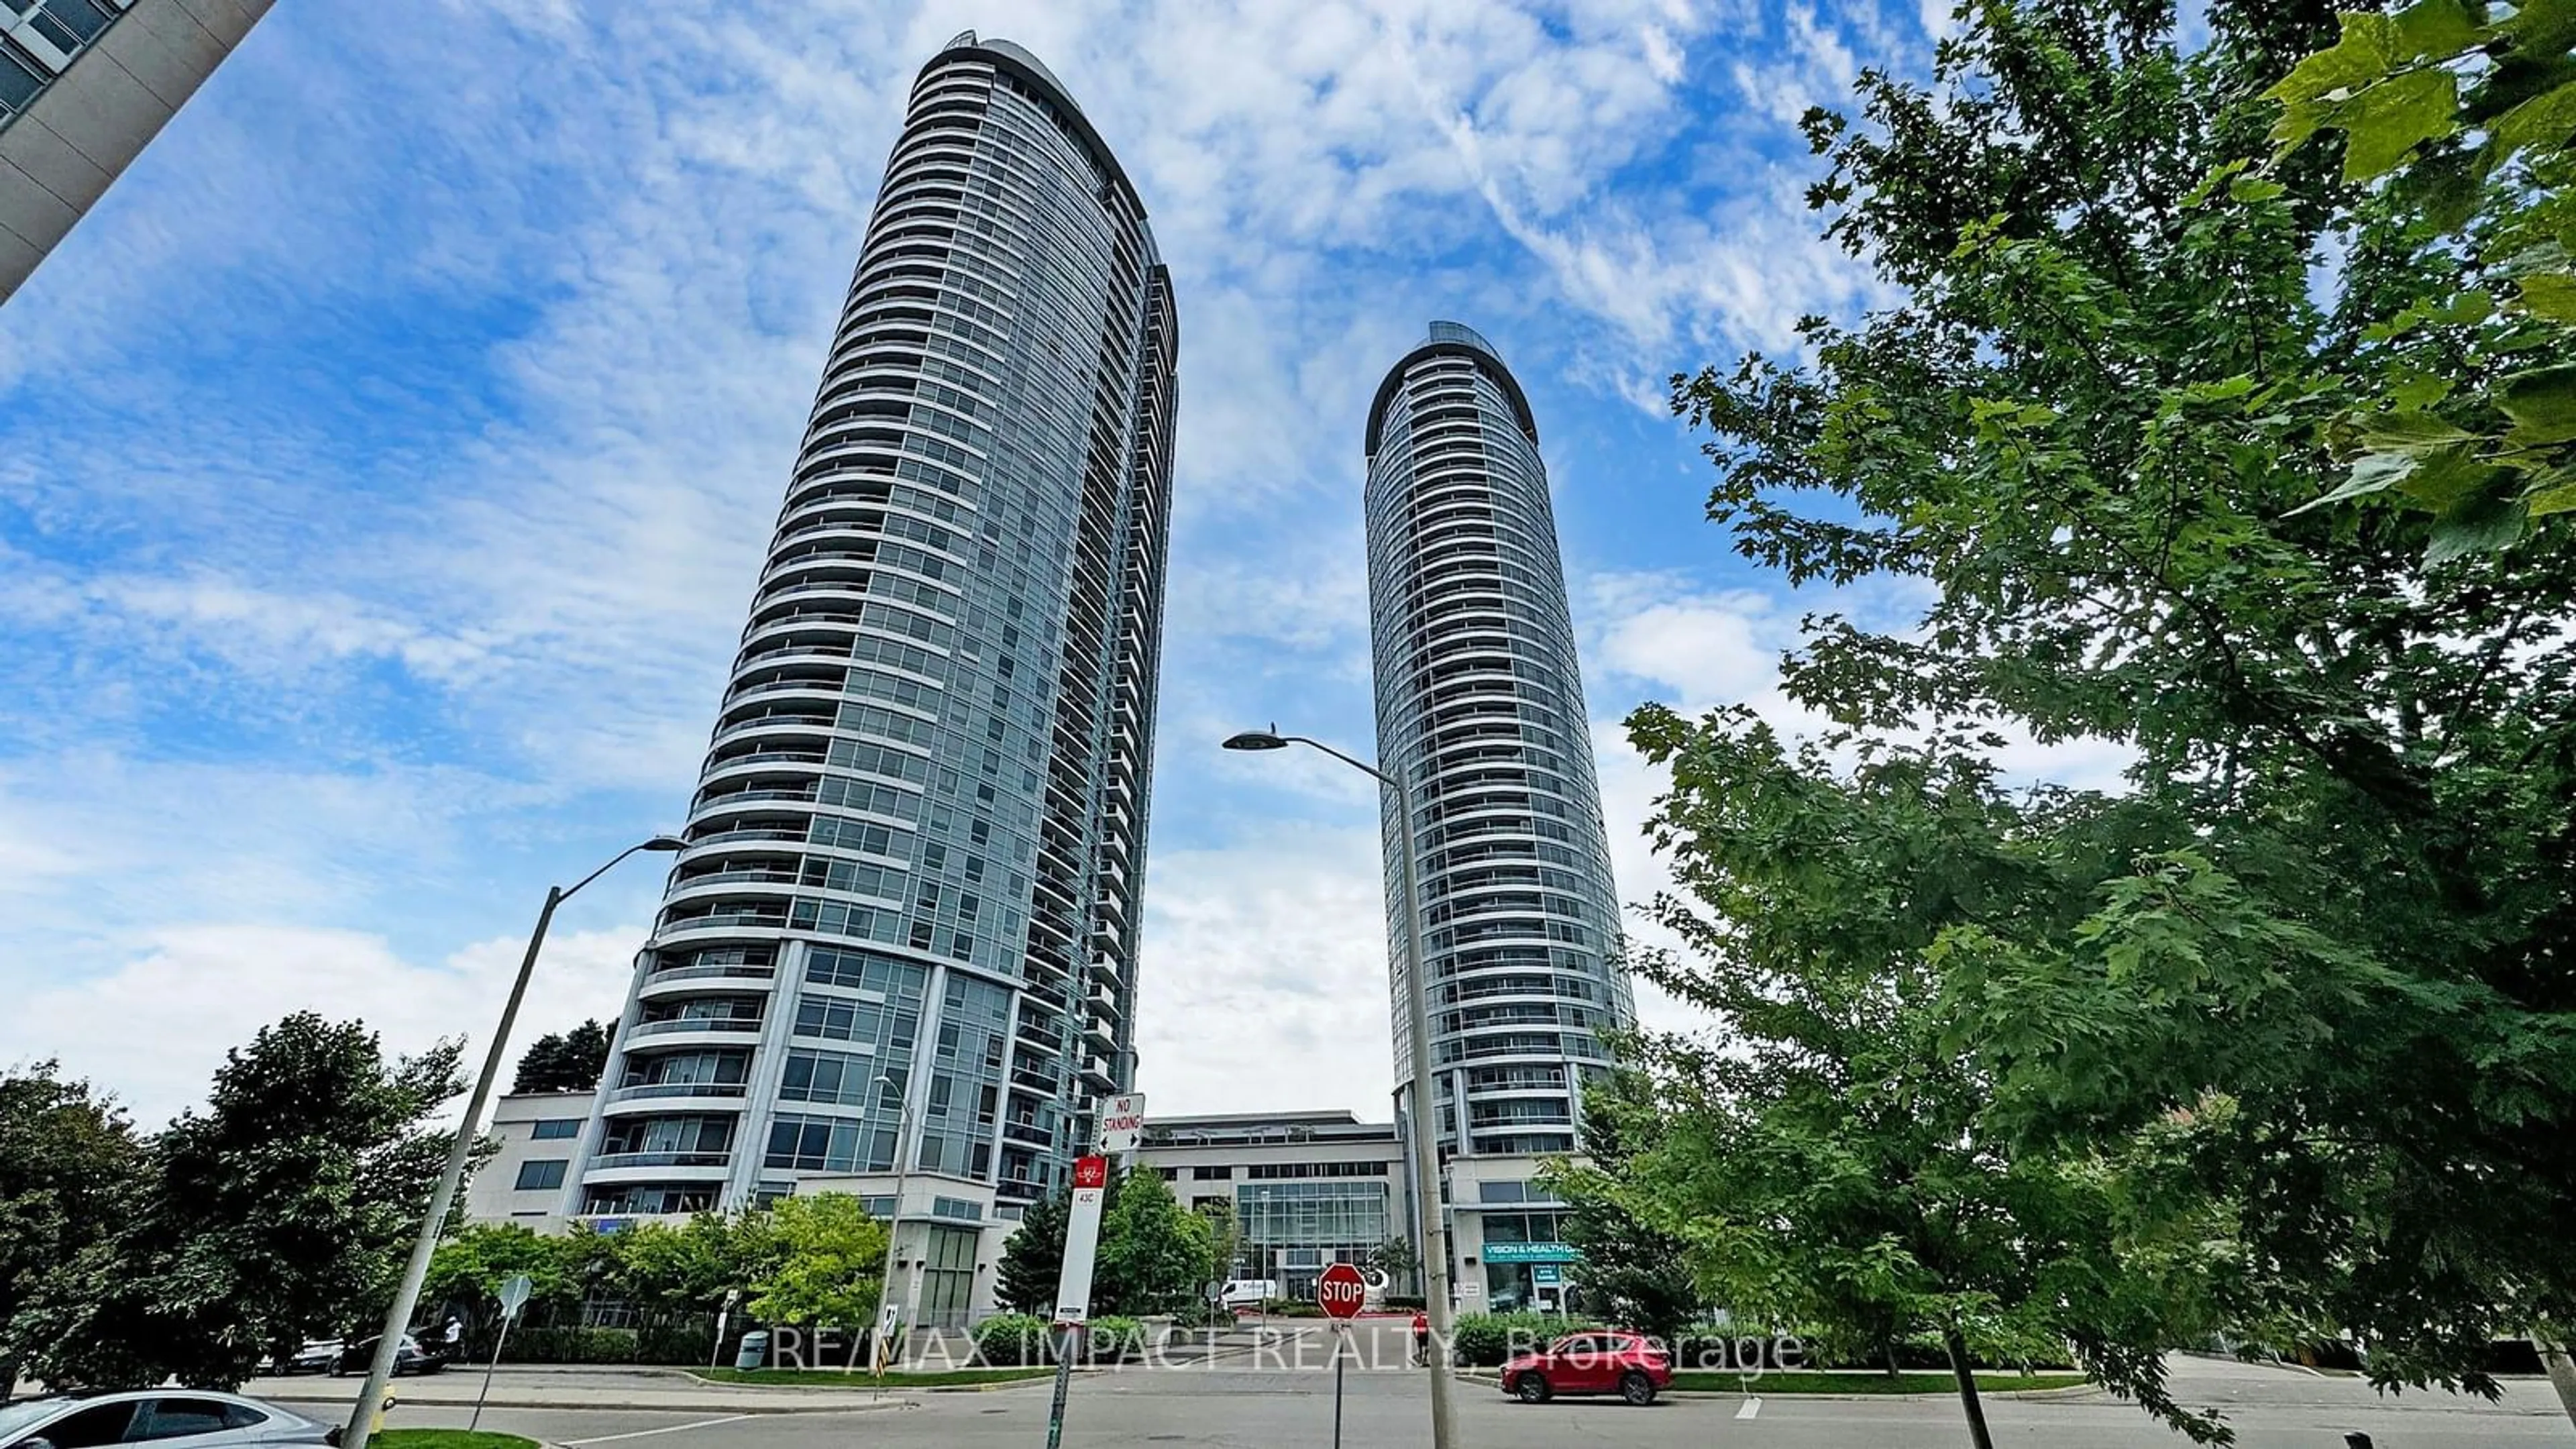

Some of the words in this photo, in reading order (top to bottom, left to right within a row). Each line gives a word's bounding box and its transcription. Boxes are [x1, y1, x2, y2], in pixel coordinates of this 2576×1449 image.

[1116, 1099, 1131, 1112] NO
[1104, 1114, 1140, 1132] STANDING
[1486, 1245, 1517, 1254] VISION
[1519, 1245, 1525, 1253] &
[1527, 1244, 1564, 1253] HEALTH
[1323, 1280, 1363, 1302] STOP
